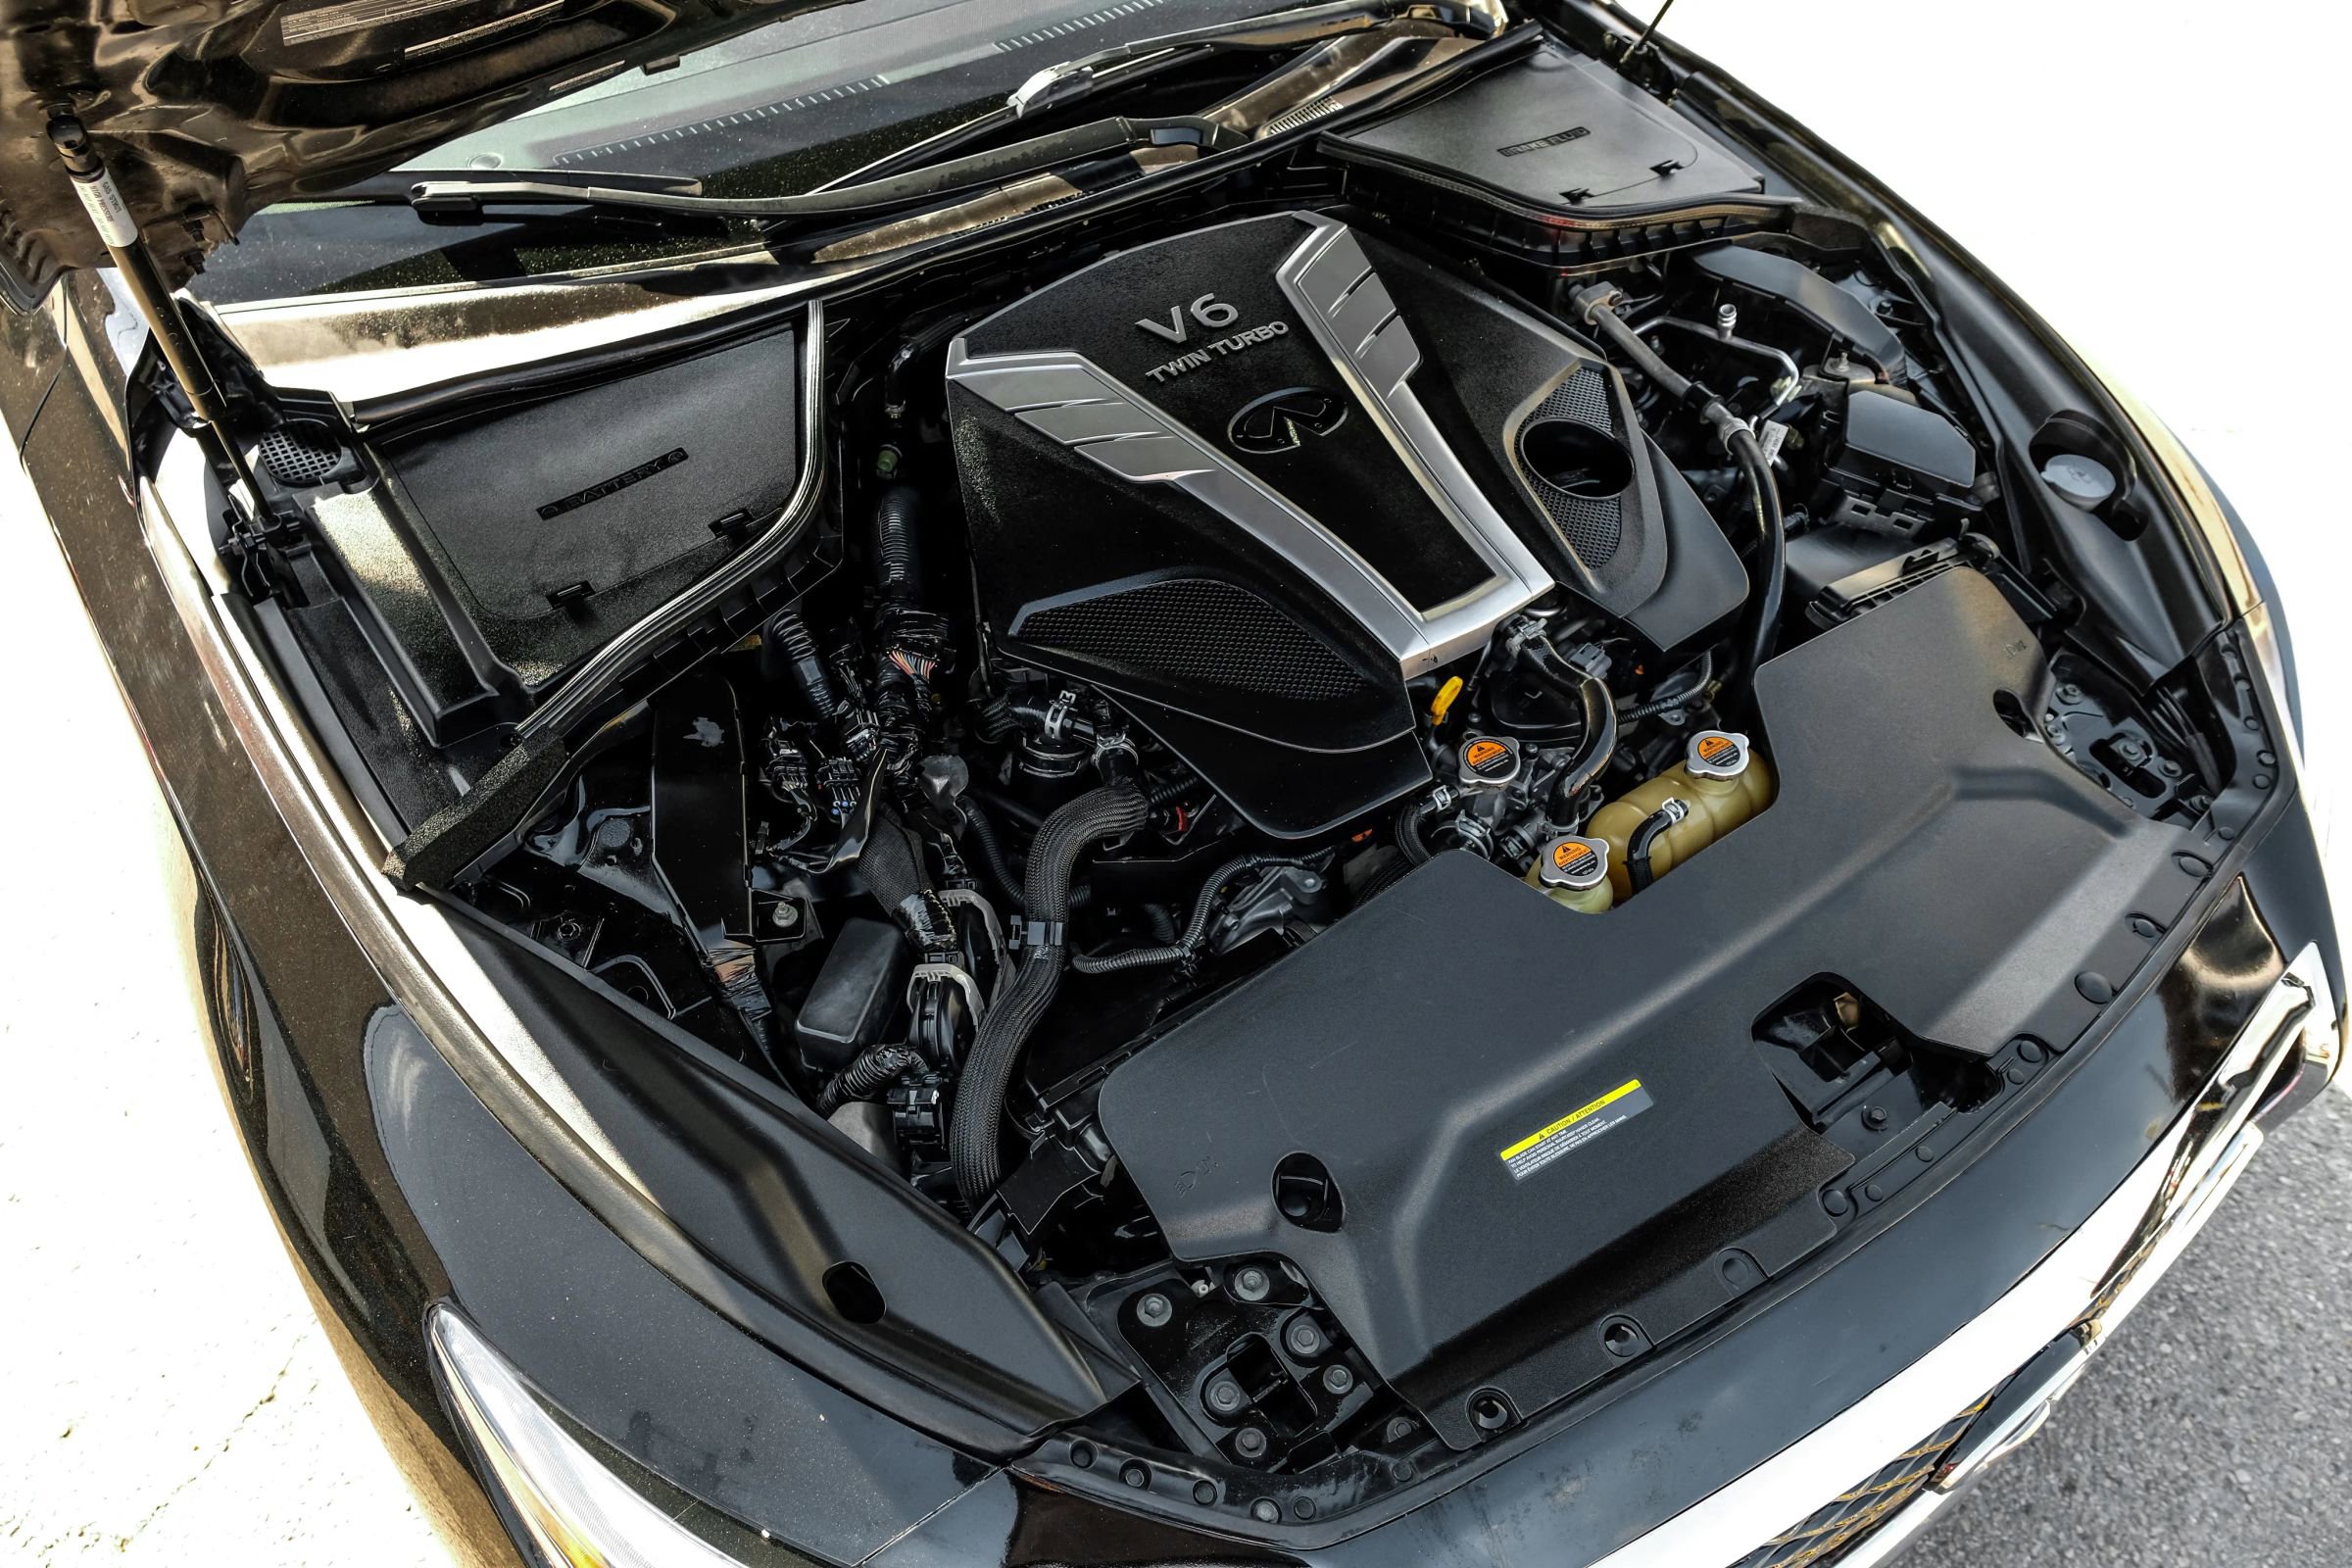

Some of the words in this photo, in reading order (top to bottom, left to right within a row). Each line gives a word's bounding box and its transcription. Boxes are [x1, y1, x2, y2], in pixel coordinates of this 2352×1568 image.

[1501, 139, 1549, 156] BRAKE
[1547, 127, 1587, 145] FLUID
[1134, 292, 1239, 343] V6
[1145, 349, 1212, 383] TWIN
[1206, 320, 1290, 356] TURBO
[565, 461, 663, 509] BATTERY
[1559, 846, 1582, 860] WARNING
[1546, 1118, 1571, 1135] CAUTION
[1575, 1100, 1605, 1118] ATTENTION
